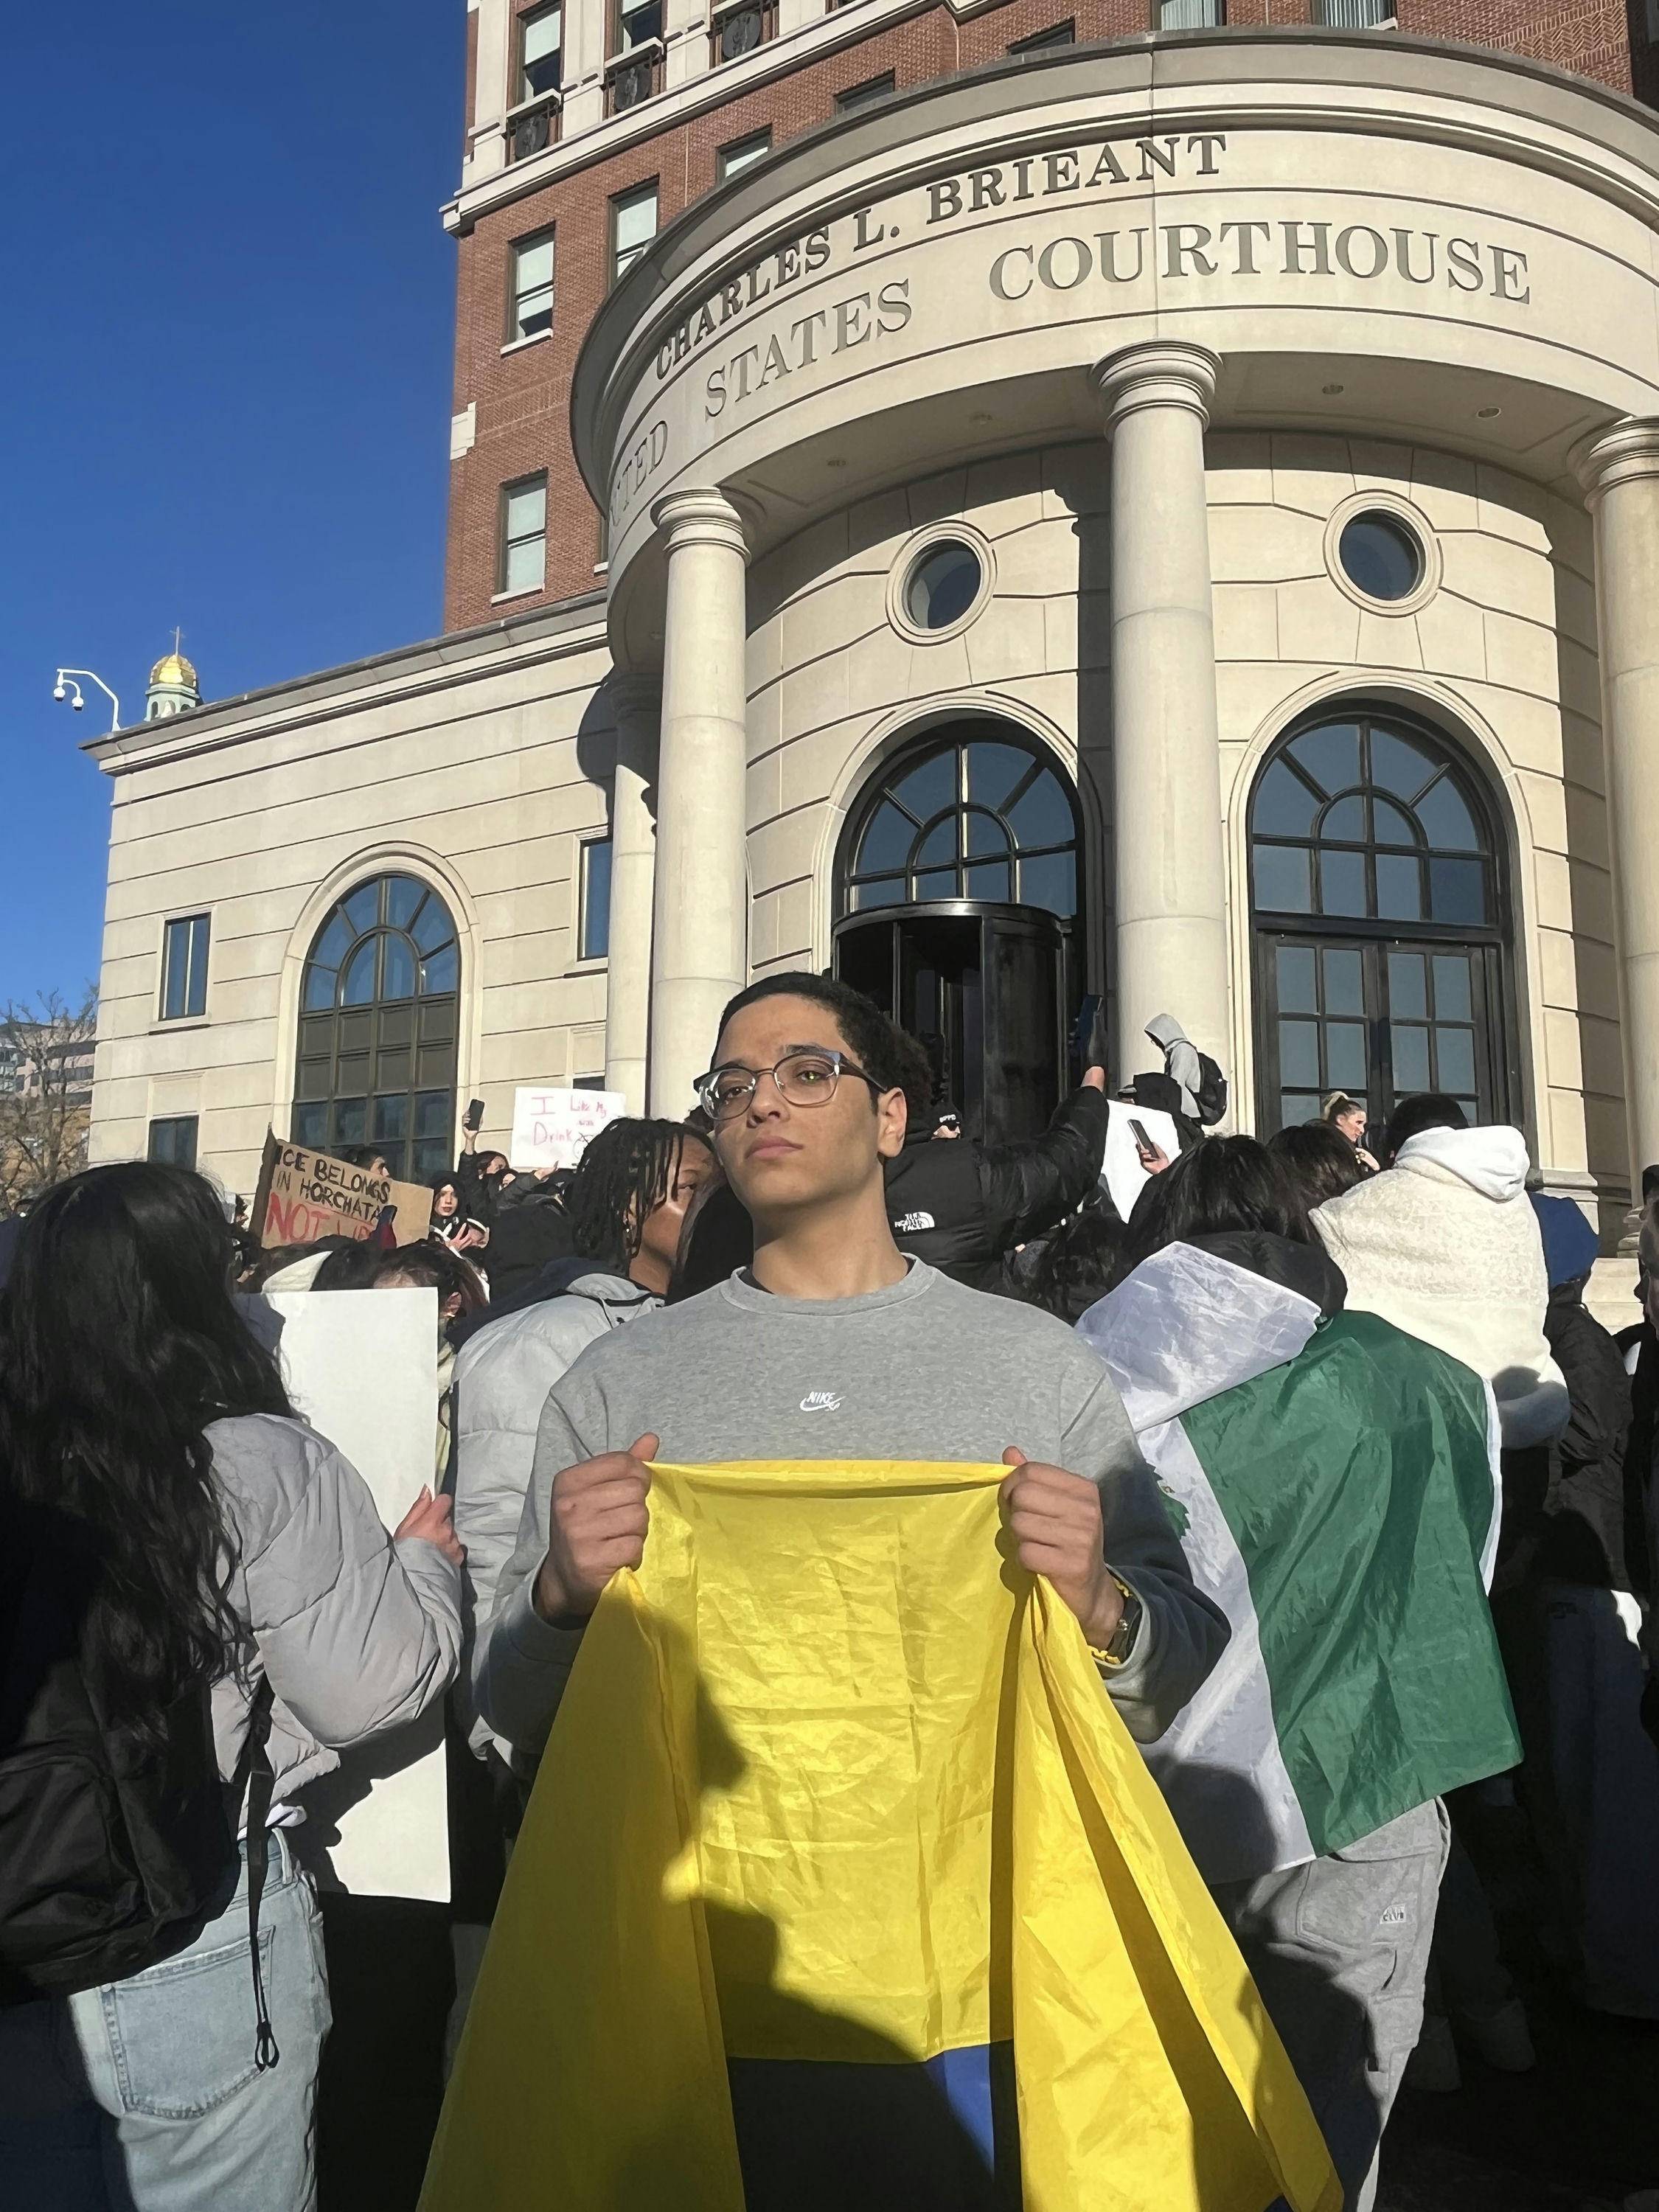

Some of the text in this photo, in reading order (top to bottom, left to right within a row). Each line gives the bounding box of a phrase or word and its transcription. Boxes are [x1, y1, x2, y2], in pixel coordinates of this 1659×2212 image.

[655, 134, 1226, 380] CHARLES L. BRIEANT
[705, 278, 913, 422] STATES
[989, 220, 1531, 306] COURTHOUSE
[534, 1121, 574, 1147] Drink
[276, 1145, 391, 1204] ICE BELONGS
[276, 1170, 292, 1192] IN
[265, 1192, 331, 1242] NOT
[807, 1391, 835, 1404] NIKE
